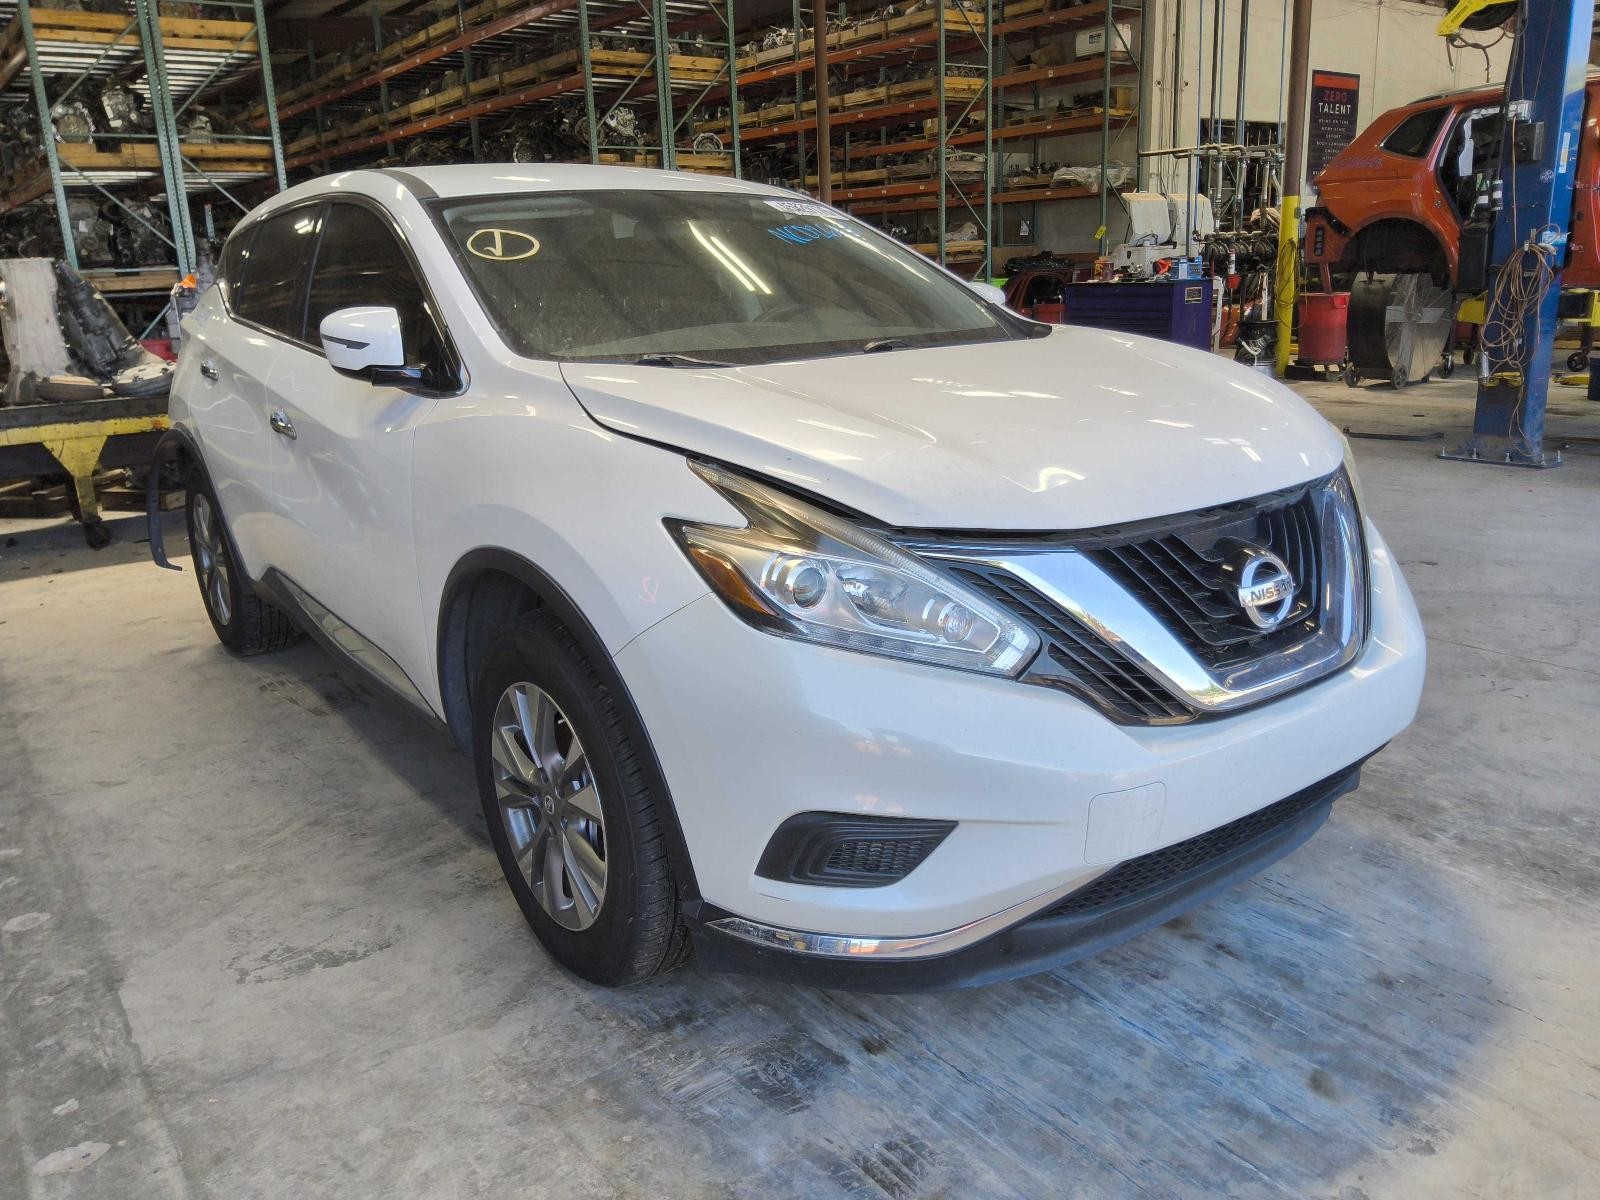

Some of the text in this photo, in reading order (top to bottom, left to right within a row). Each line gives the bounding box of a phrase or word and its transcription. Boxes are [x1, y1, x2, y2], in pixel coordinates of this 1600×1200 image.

[1323, 90, 1348, 103] ZERO
[1318, 102, 1351, 115] TALENT
[1250, 578, 1292, 602] NISSAN
